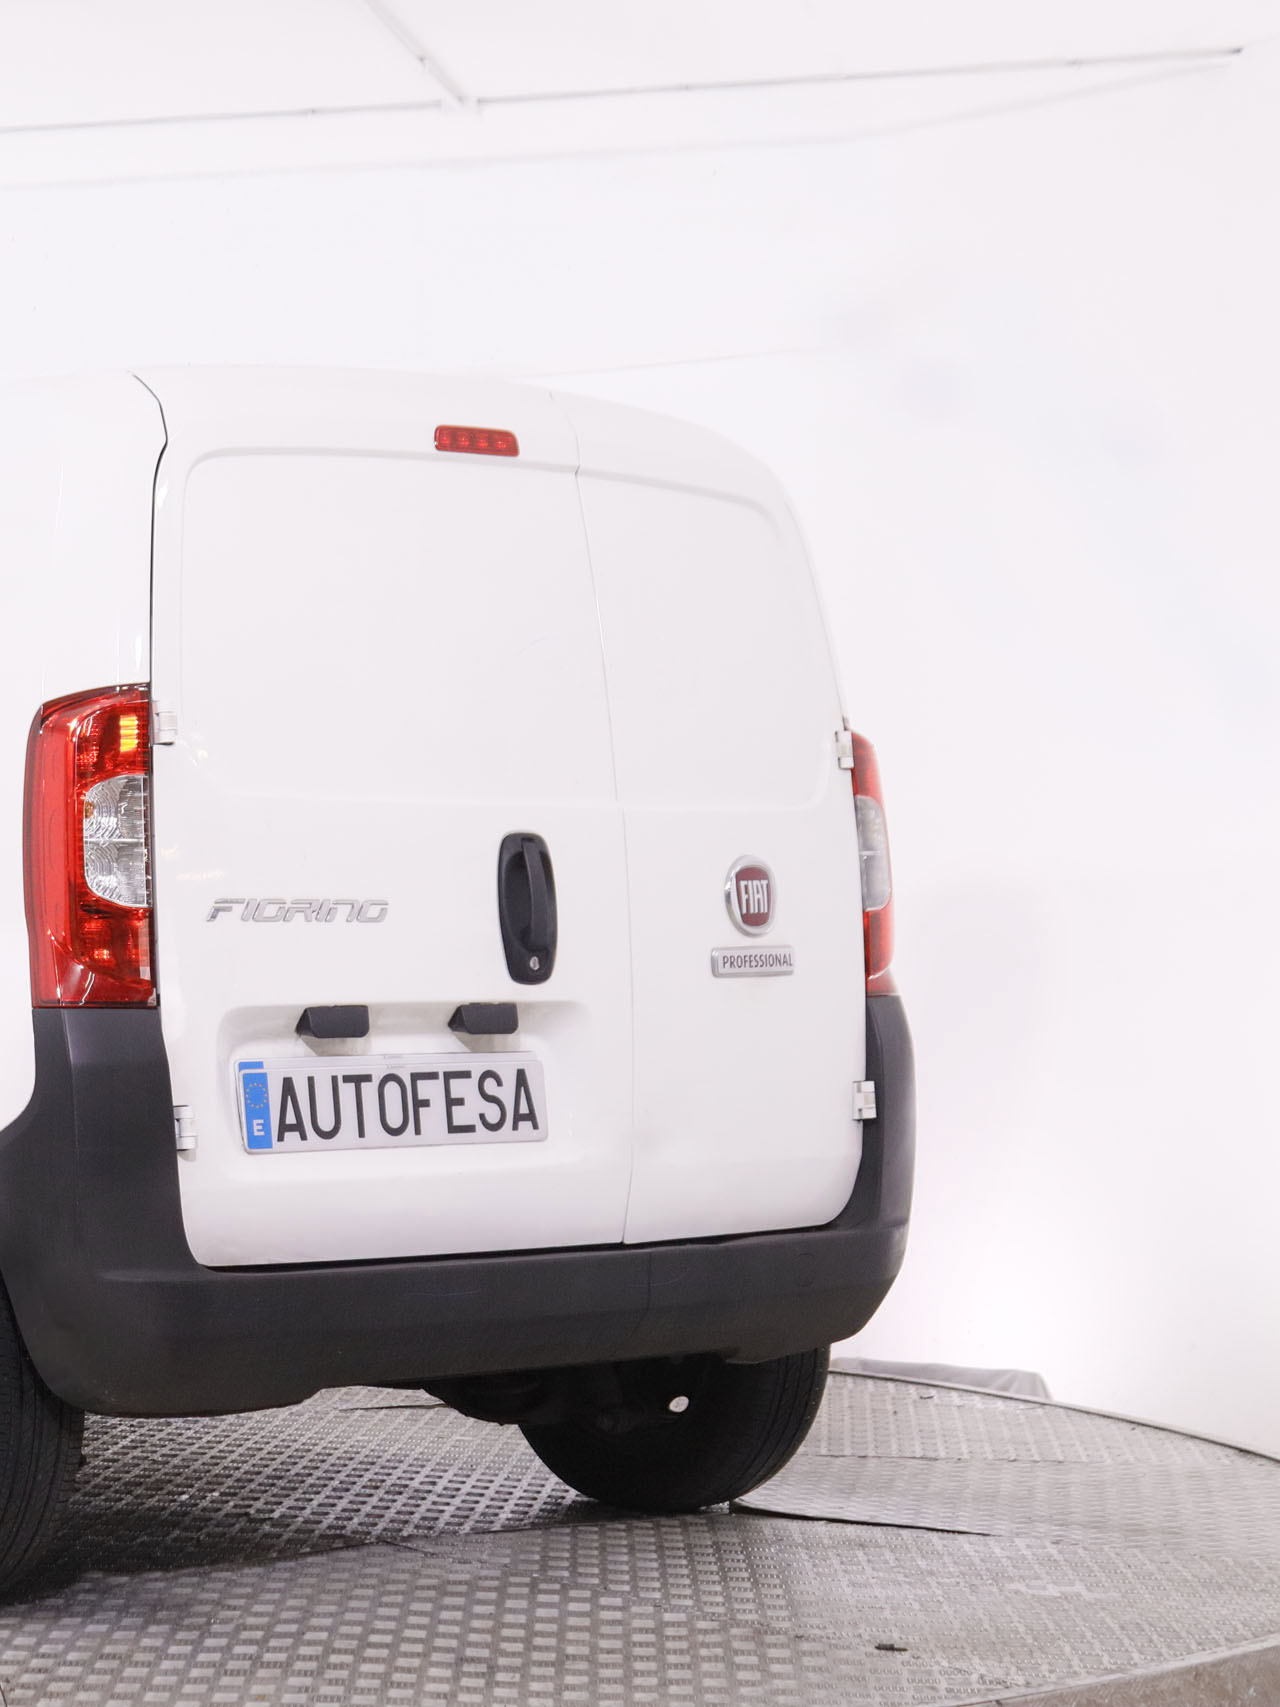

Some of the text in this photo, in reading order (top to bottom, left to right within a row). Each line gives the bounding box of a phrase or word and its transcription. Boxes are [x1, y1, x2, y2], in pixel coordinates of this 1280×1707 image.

[206, 898, 389, 922] FIORINO
[740, 880, 769, 914] FIAT
[722, 953, 793, 968] PROFESSIONAL
[252, 1068, 539, 1142] E AUTOFESA
